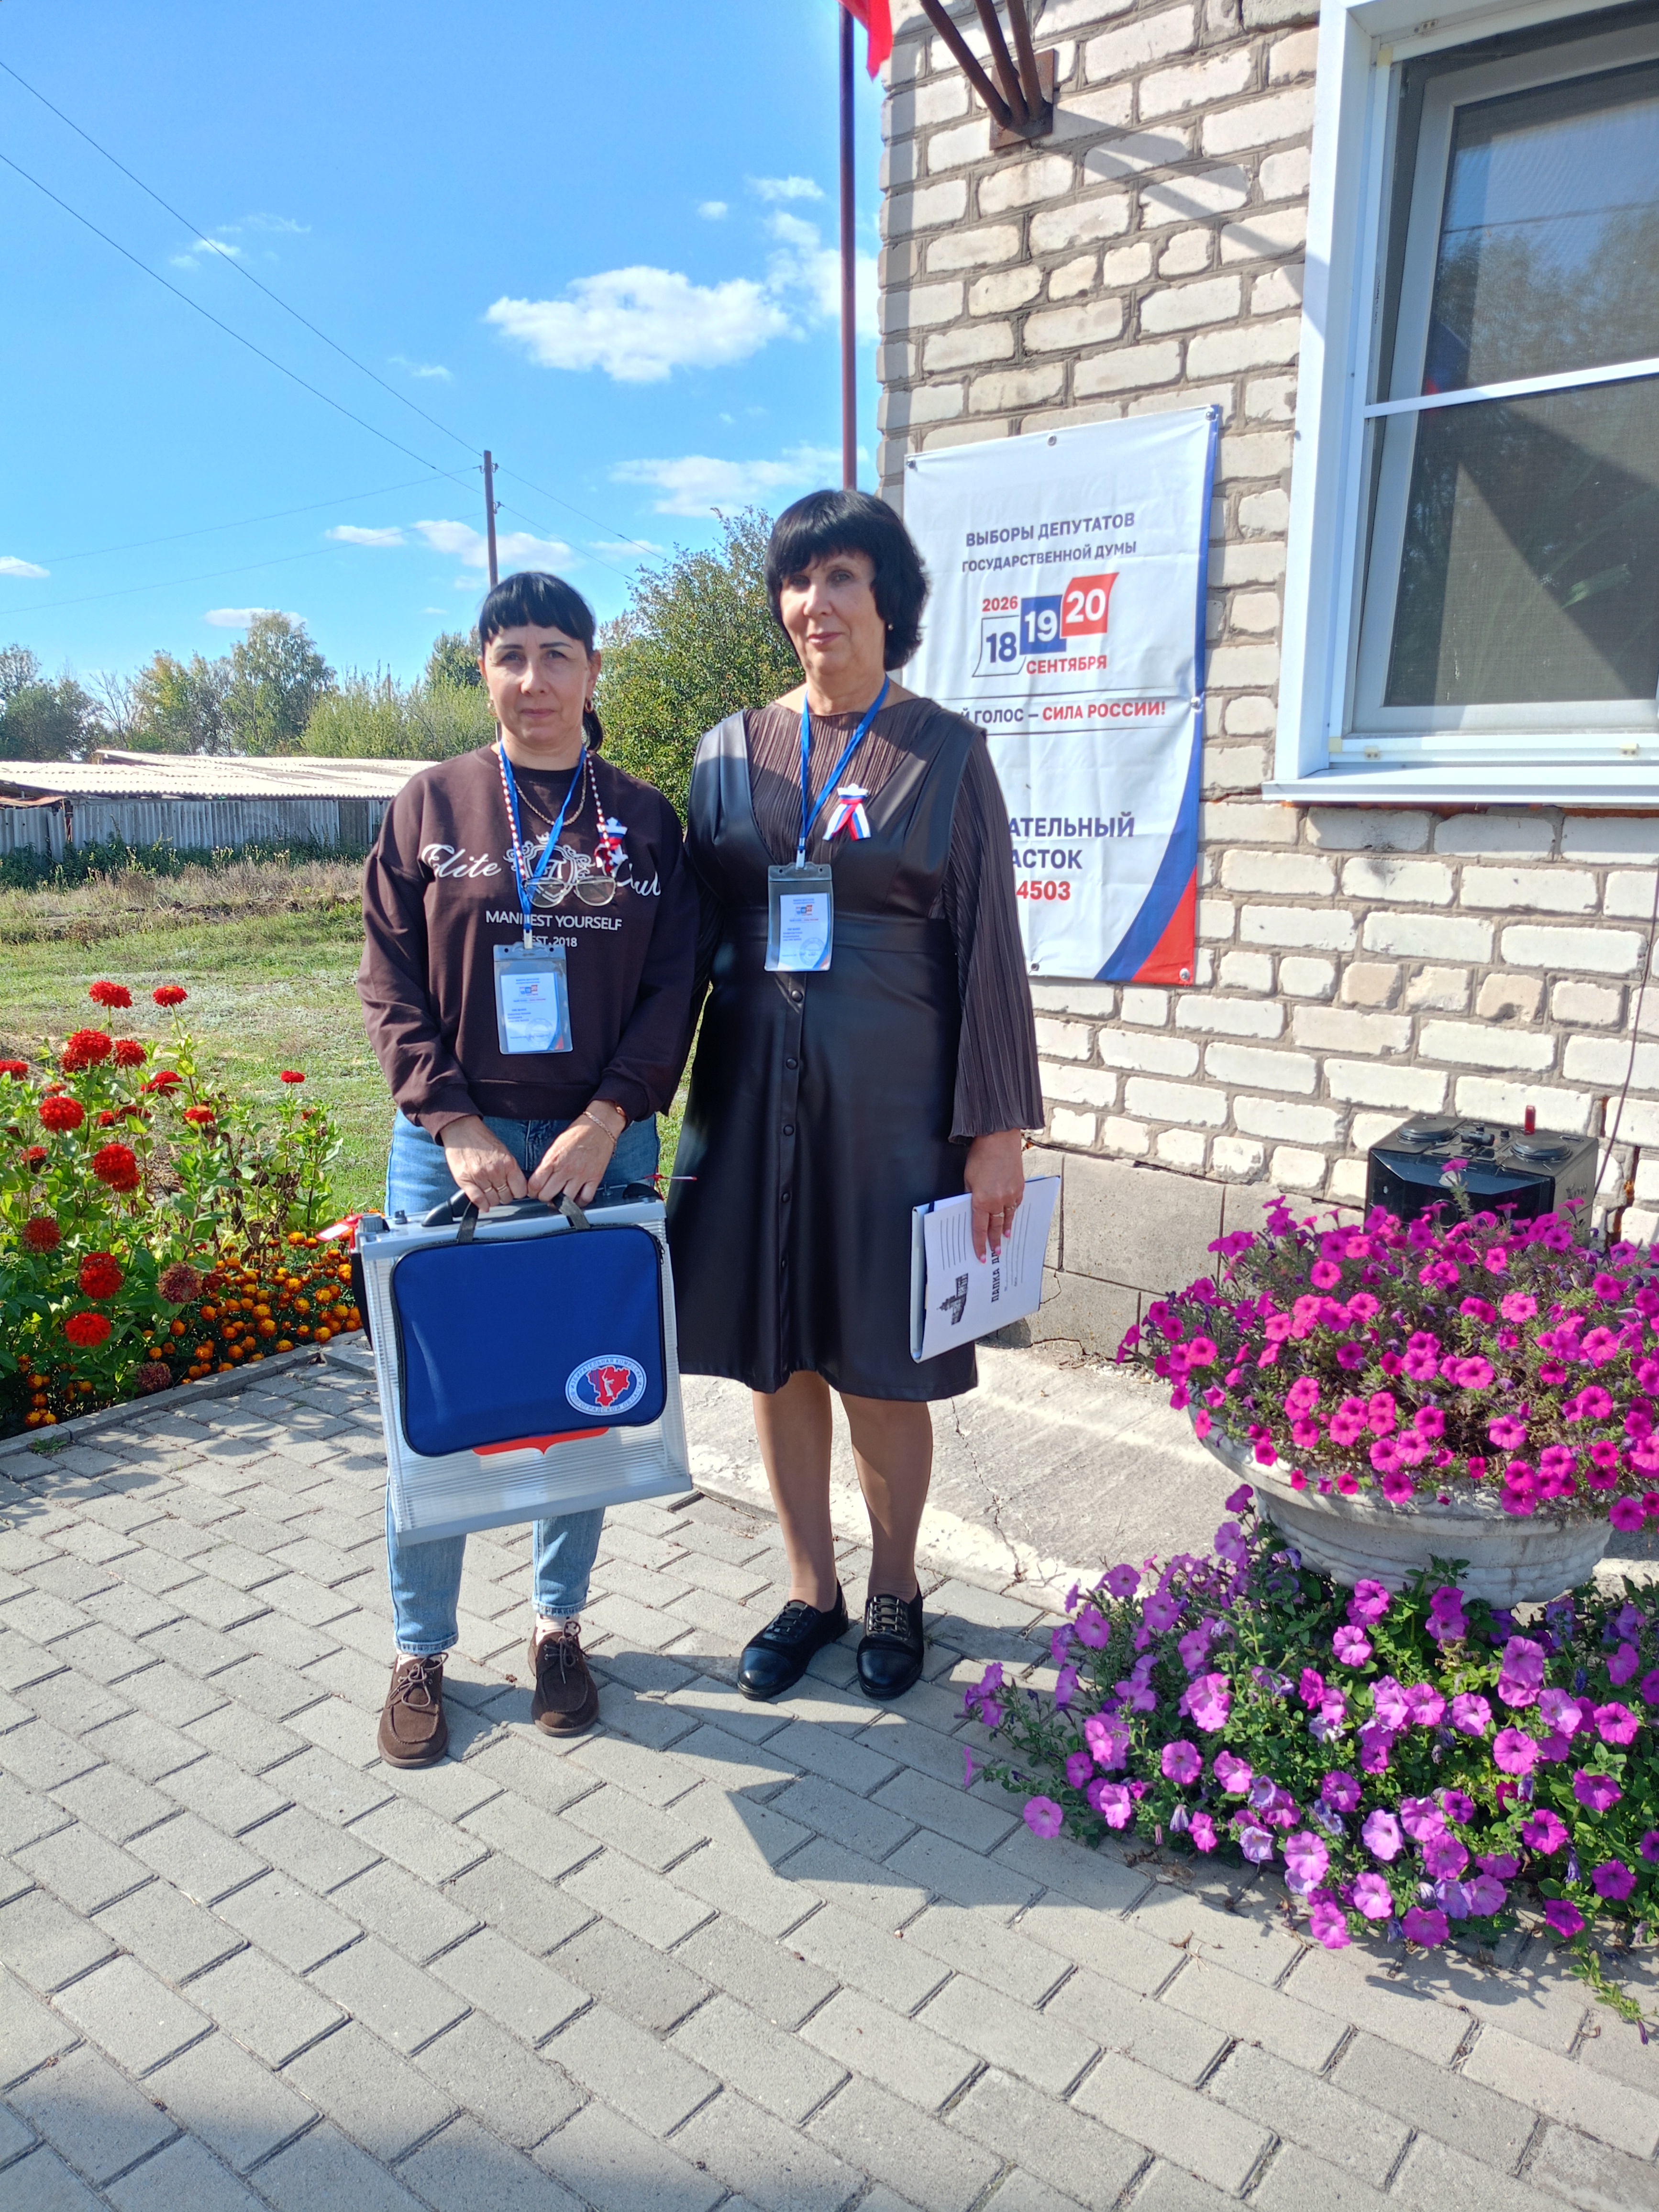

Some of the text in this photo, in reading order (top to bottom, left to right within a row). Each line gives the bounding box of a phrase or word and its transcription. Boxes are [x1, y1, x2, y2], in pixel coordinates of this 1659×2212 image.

[966, 512, 1135, 547] ВЫБОРЫ ДЕПУТАТОВ
[962, 541, 1137, 573] ГОСУДАРСТВЕННОЙ ДУМЫ
[982, 596, 1018, 612] 2026
[986, 588, 1106, 664] 18 19 20
[1026, 654, 1107, 675] СЕНТЯБРЯ
[974, 708, 1024, 724] ГОЛОС
[1042, 705, 1084, 721] СИЛА
[1087, 701, 1166, 718] РОССИИ!
[1008, 811, 1135, 838] АТЕЛЬНЫЙ
[421, 843, 502, 878] Elite
[1012, 849, 1083, 870] АСТОК
[1016, 880, 1071, 901] 4503
[486, 910, 622, 931] MANIEST YOURSELF
[992, 1268, 1000, 1302] ПАПКА
[570, 1359, 642, 1389] ИЗБИРАТЕЛЬНАЯ КОМИССИЯ
[623, 1381, 642, 1407] ОБЛАСТИ
